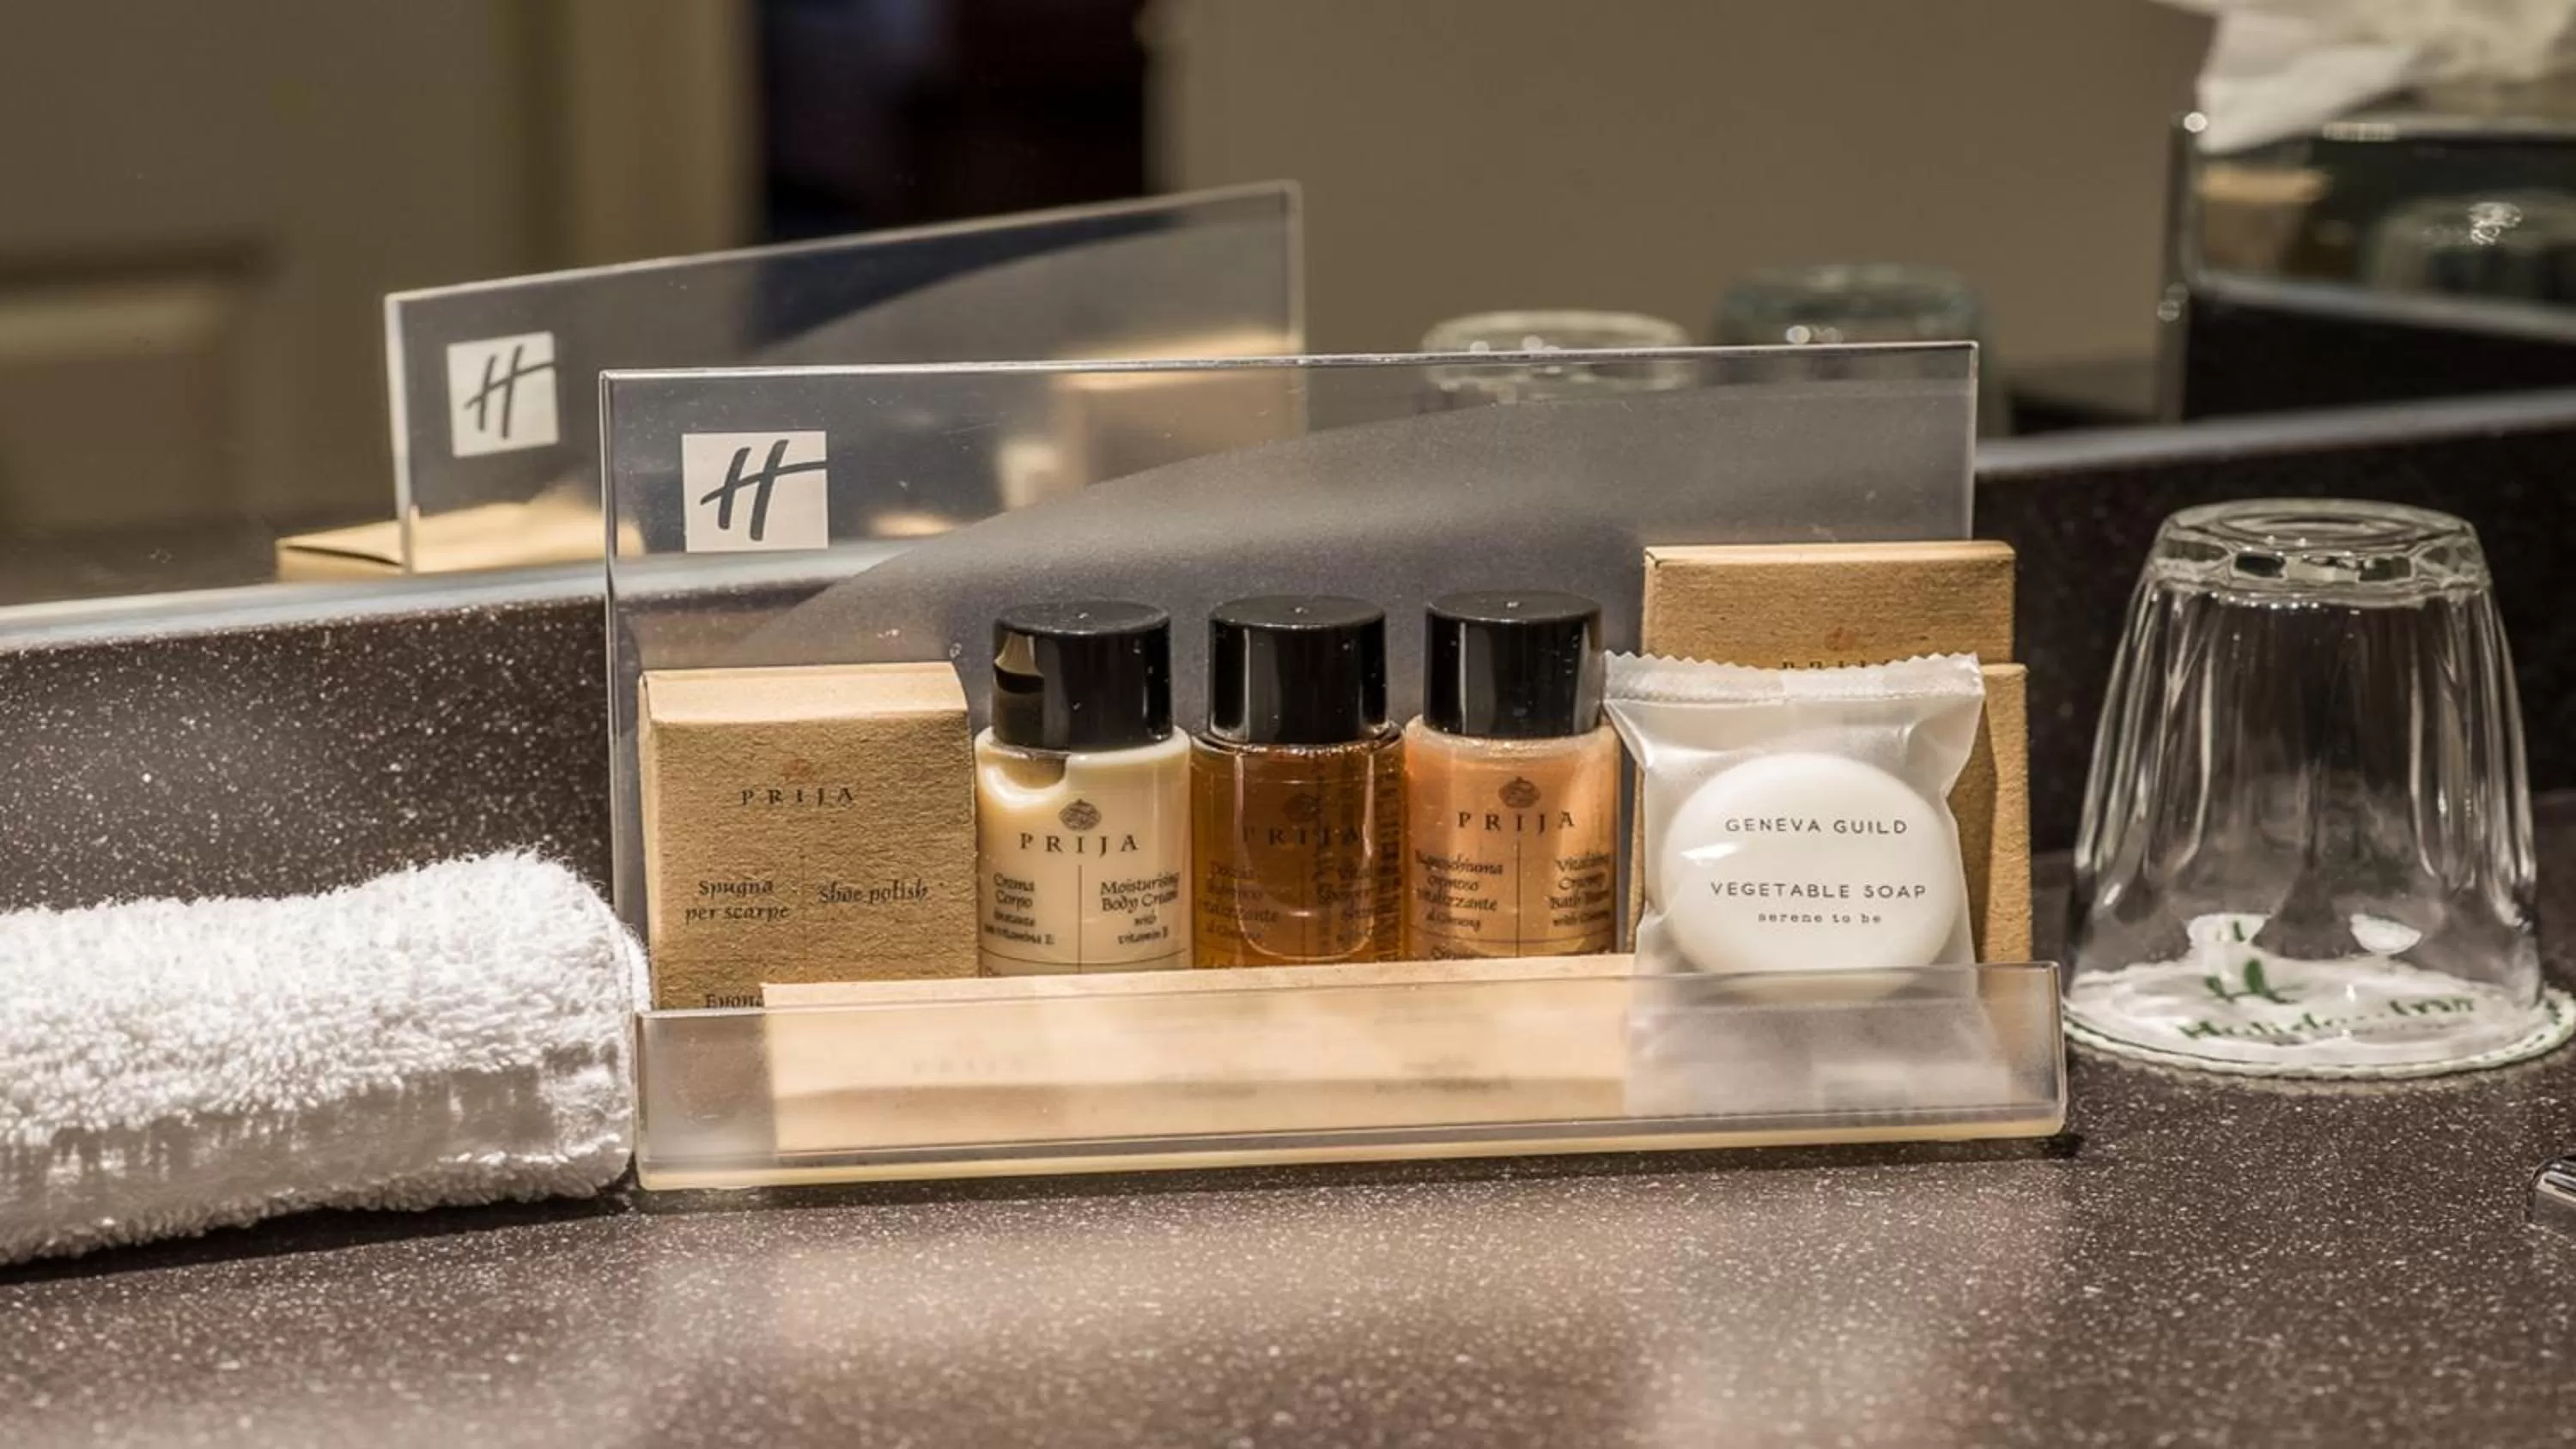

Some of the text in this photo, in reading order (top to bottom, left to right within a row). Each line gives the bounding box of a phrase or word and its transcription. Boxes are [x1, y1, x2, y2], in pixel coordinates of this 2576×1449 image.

[700, 439, 828, 542] H
[741, 787, 854, 805] PRIJA
[1458, 810, 1574, 834] PRIJA
[1724, 817, 1908, 835] GENEVA GUILD
[1019, 833, 1139, 858] PRIJA
[819, 882, 864, 902] Shoe
[1710, 882, 1927, 900] VEGETABLE SOAP
[1102, 894, 1139, 914] Body
[685, 905, 791, 925] per scarpe
[1757, 912, 1882, 925] serene to be
